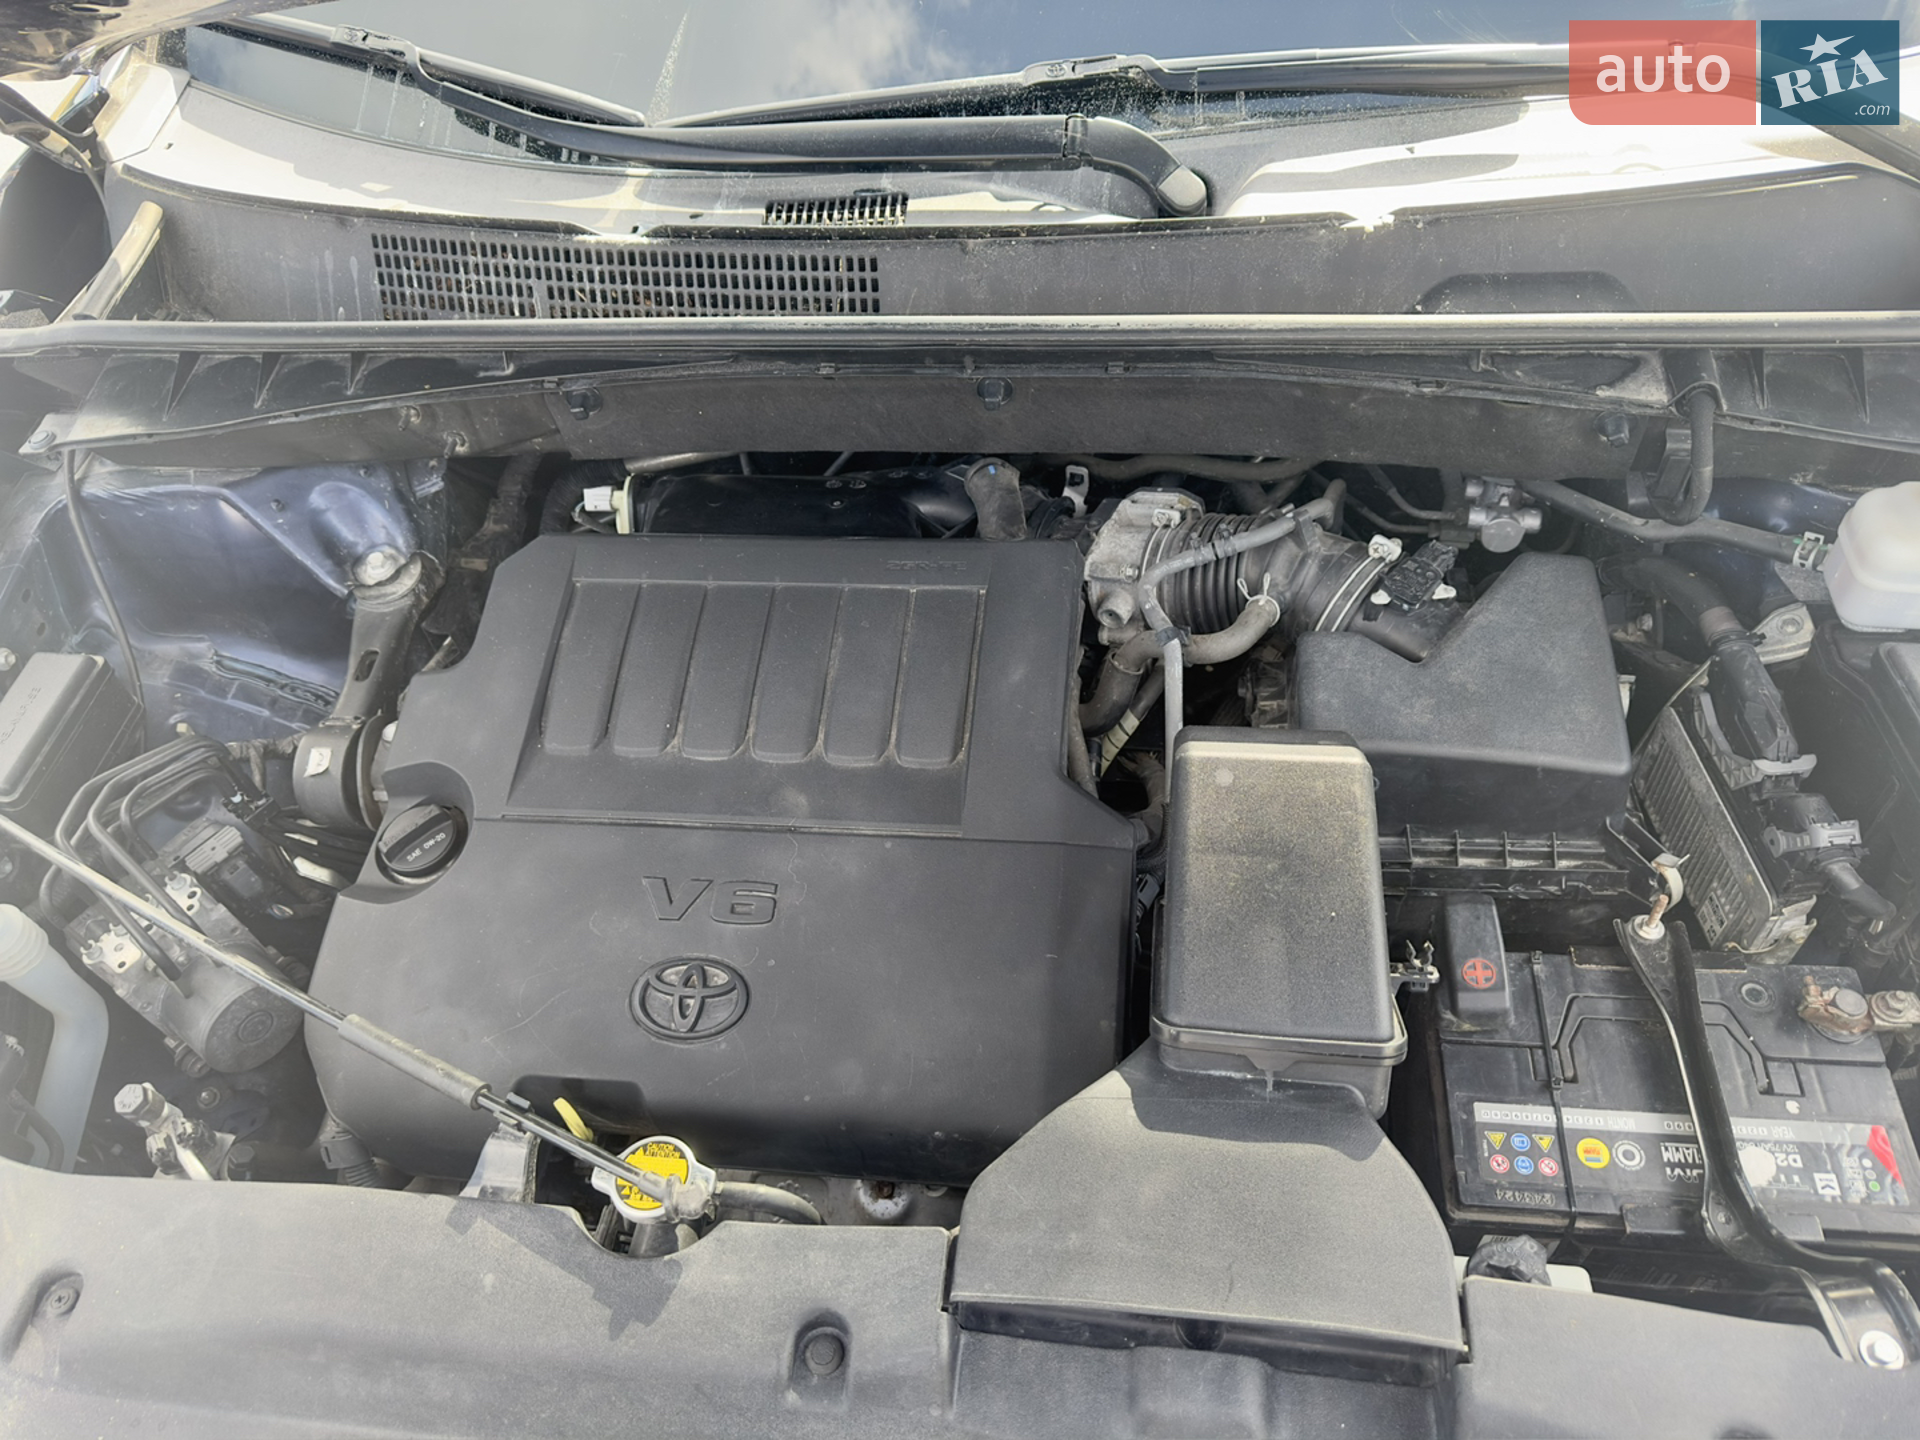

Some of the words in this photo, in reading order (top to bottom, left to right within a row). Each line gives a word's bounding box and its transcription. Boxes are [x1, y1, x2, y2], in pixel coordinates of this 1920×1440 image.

[407, 849, 422, 863] SAE
[423, 832, 446, 850] 0W-20
[642, 876, 778, 925] V6
[645, 1150, 680, 1159] ATTENTION
[648, 1142, 675, 1151] CAUTION
[1660, 1146, 1702, 1164] IAMM
